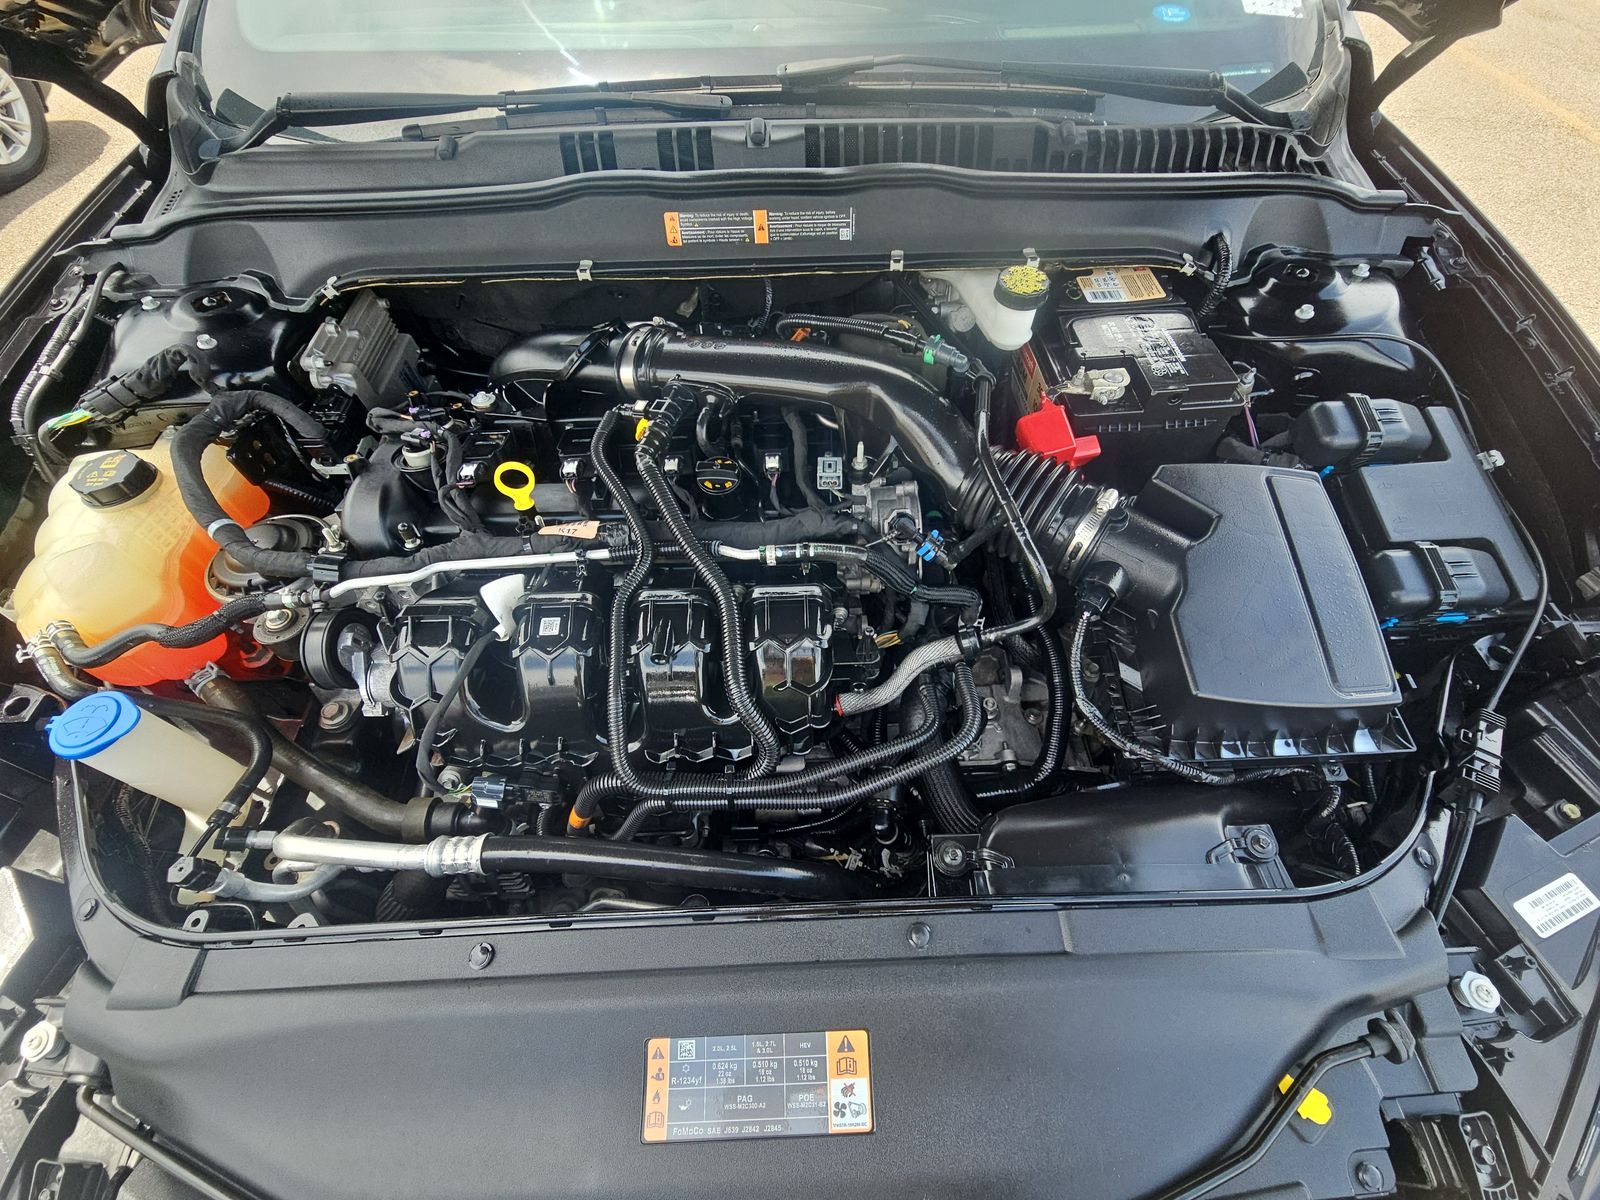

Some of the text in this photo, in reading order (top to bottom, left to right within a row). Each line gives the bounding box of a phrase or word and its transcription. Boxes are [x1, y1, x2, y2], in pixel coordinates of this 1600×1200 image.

[730, 1062, 738, 1071] kg
[770, 1060, 778, 1069] kg
[810, 1059, 818, 1068] kg
[671, 1076, 702, 1085] R-1234yf
[798, 1093, 815, 1102] POE
[672, 1124, 782, 1136] FoMoCo SAE J639 J2842 J2845
